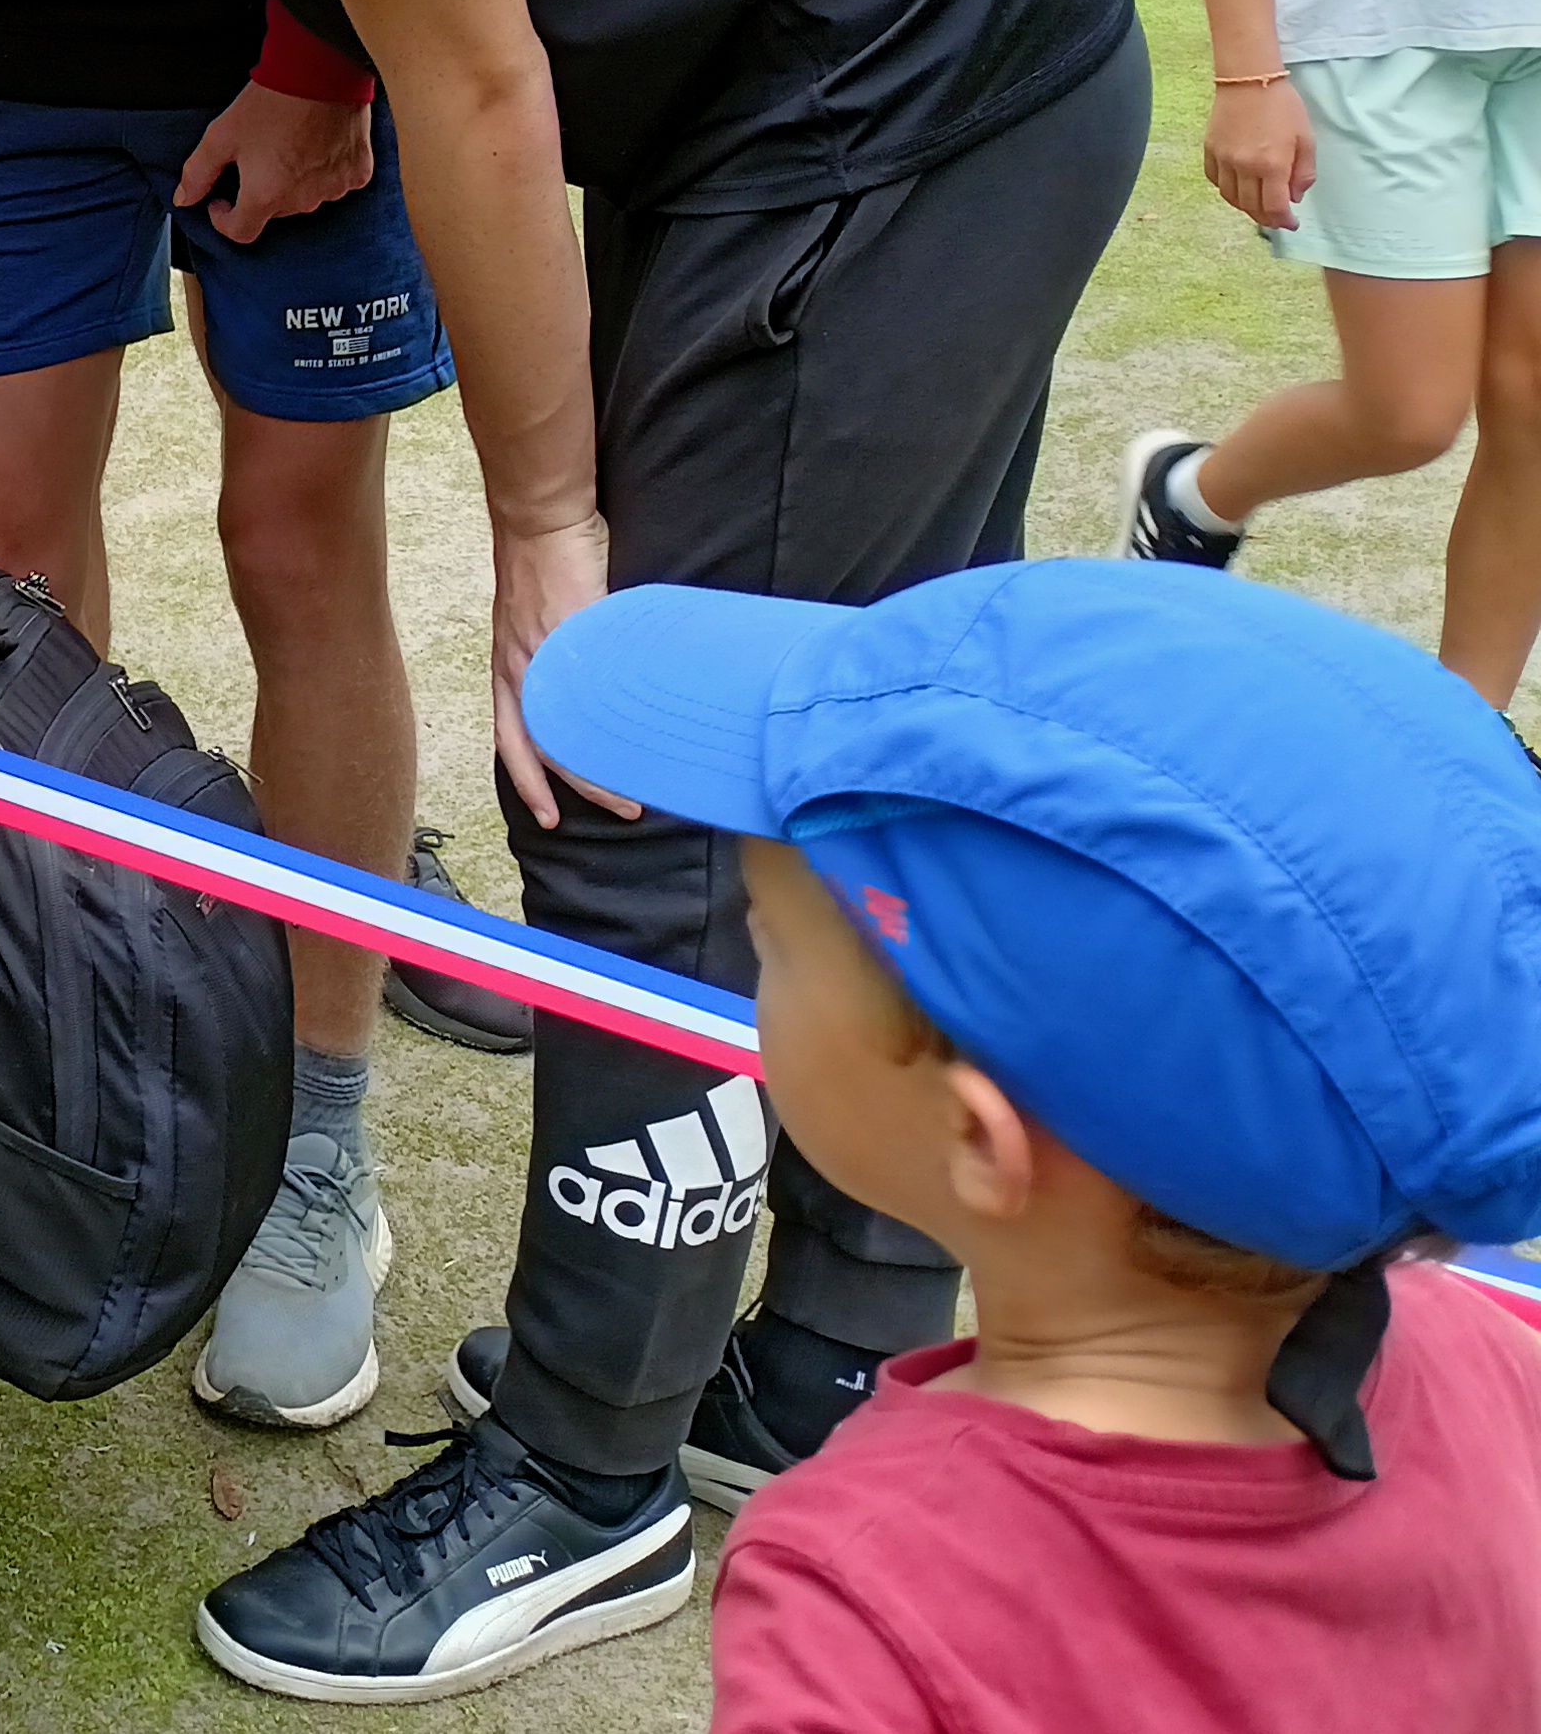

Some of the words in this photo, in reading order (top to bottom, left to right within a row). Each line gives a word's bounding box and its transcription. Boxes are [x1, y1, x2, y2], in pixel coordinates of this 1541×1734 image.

[286, 306, 344, 329] NEW
[356, 292, 410, 324] YORK
[294, 359, 323, 368] UNITED
[328, 357, 355, 368] STATES
[359, 355, 369, 365] OF
[372, 347, 401, 363] AMERICA
[335, 342, 347, 352] US
[485, 1555, 534, 1588] PUMA
